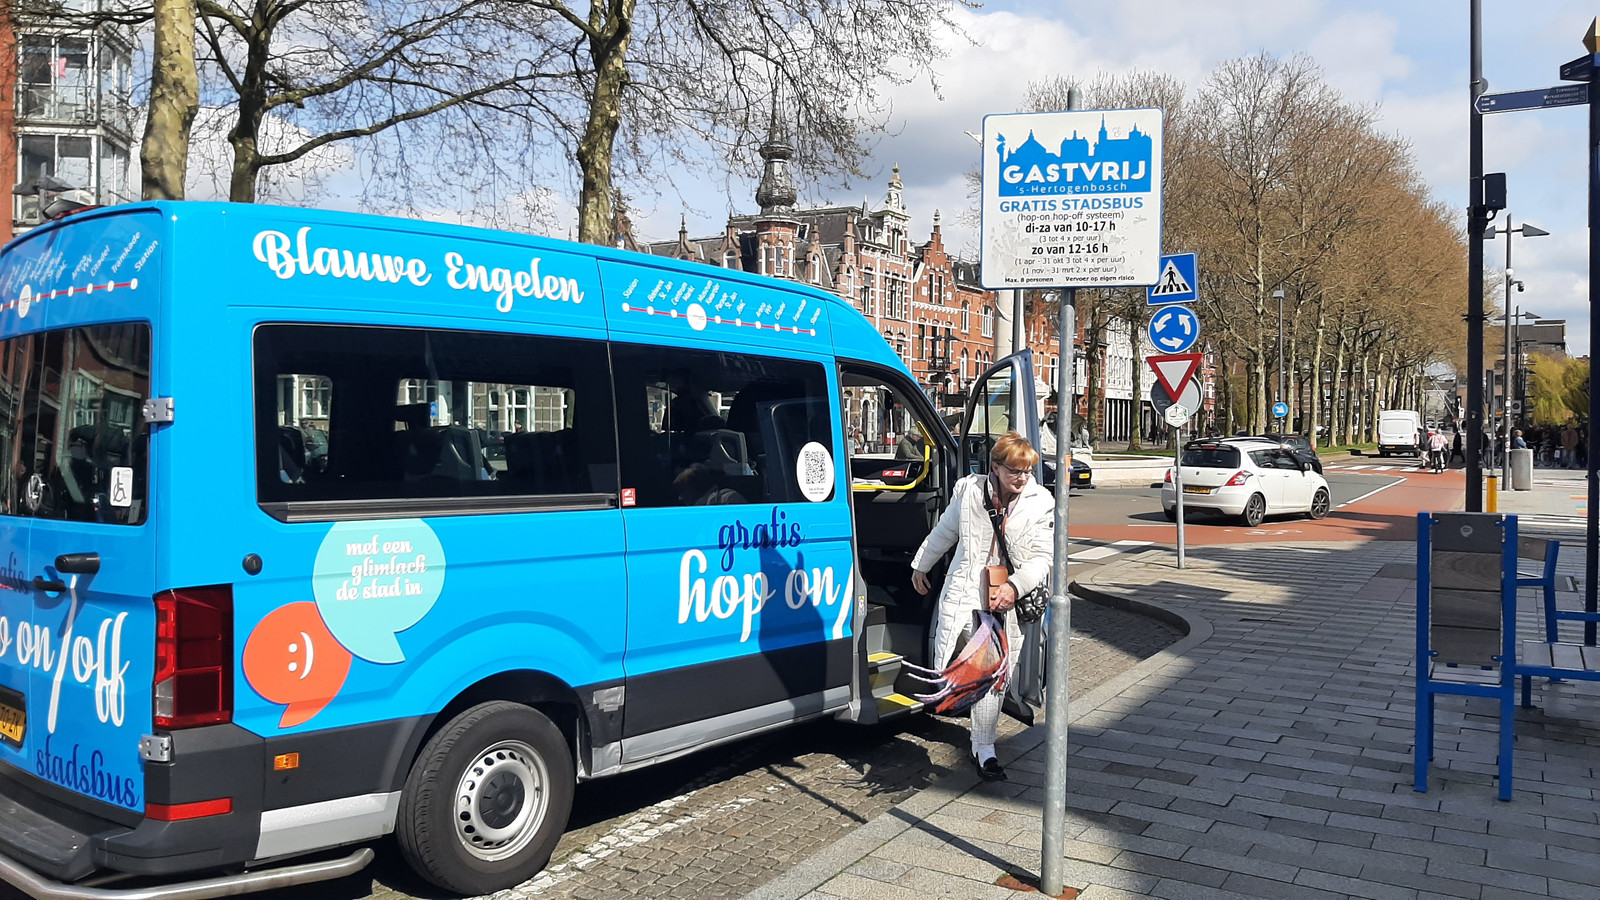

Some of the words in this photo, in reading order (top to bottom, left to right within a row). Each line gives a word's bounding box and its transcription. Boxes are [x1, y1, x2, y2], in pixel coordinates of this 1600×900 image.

[1002, 160, 1146, 184] GASTVRIJ
[1000, 200, 1057, 212] GRATIS
[1062, 197, 1144, 210] STADSBUS
[1017, 213, 1050, 222] (hop-on
[1052, 212, 1084, 222] hop-off
[1086, 211, 1124, 220] systeem)
[1026, 223, 1050, 232] di-za
[1054, 224, 1072, 232] van
[1076, 221, 1106, 232] 10-17
[1109, 221, 1116, 230] h
[111, 232, 141, 273] Tramkade
[134, 240, 159, 272] Station
[1032, 246, 1044, 254] zo
[1046, 246, 1065, 254] van
[1068, 244, 1099, 254] 12-16
[1102, 243, 1108, 253] h
[1110, 256, 1126, 264] uur)
[72, 255, 87, 280] Arena
[90, 245, 110, 277] Citadel
[252, 226, 432, 286] Blauwe
[444, 252, 584, 312] Engelen
[622, 278, 639, 299] Station
[346, 534, 380, 556] met
[382, 540, 414, 554] een
[718, 506, 806, 572] gratis
[352, 554, 427, 586] glimlach
[336, 580, 360, 600] de
[362, 576, 402, 599] stad
[404, 578, 423, 596] in
[678, 549, 776, 642] hop
[36, 734, 140, 807] stadsbus
